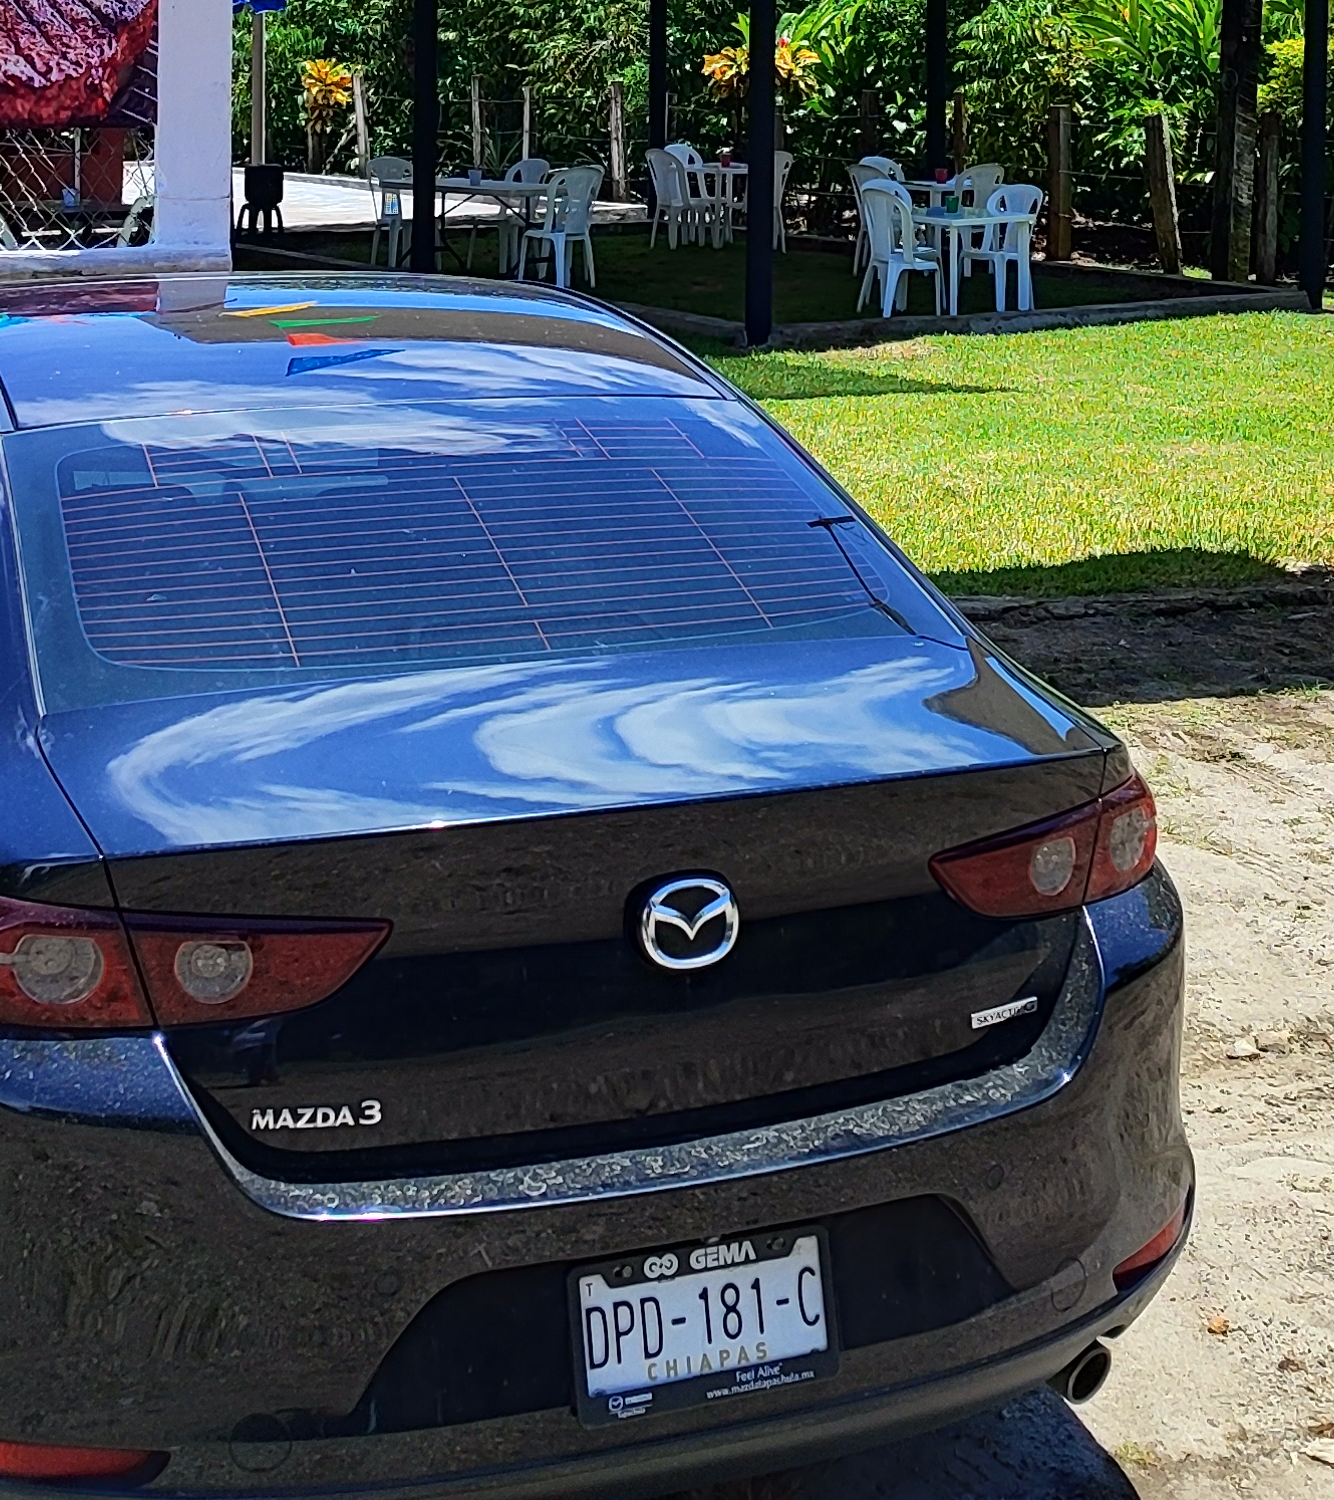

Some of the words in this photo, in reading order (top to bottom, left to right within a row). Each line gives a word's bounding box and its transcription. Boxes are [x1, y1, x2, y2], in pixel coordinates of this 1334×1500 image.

[689, 1240, 757, 1270] GEMA
[585, 1282, 594, 1297] T
[585, 1266, 821, 1370] DPD-181-C
[647, 1341, 768, 1382] CHIAPAS
